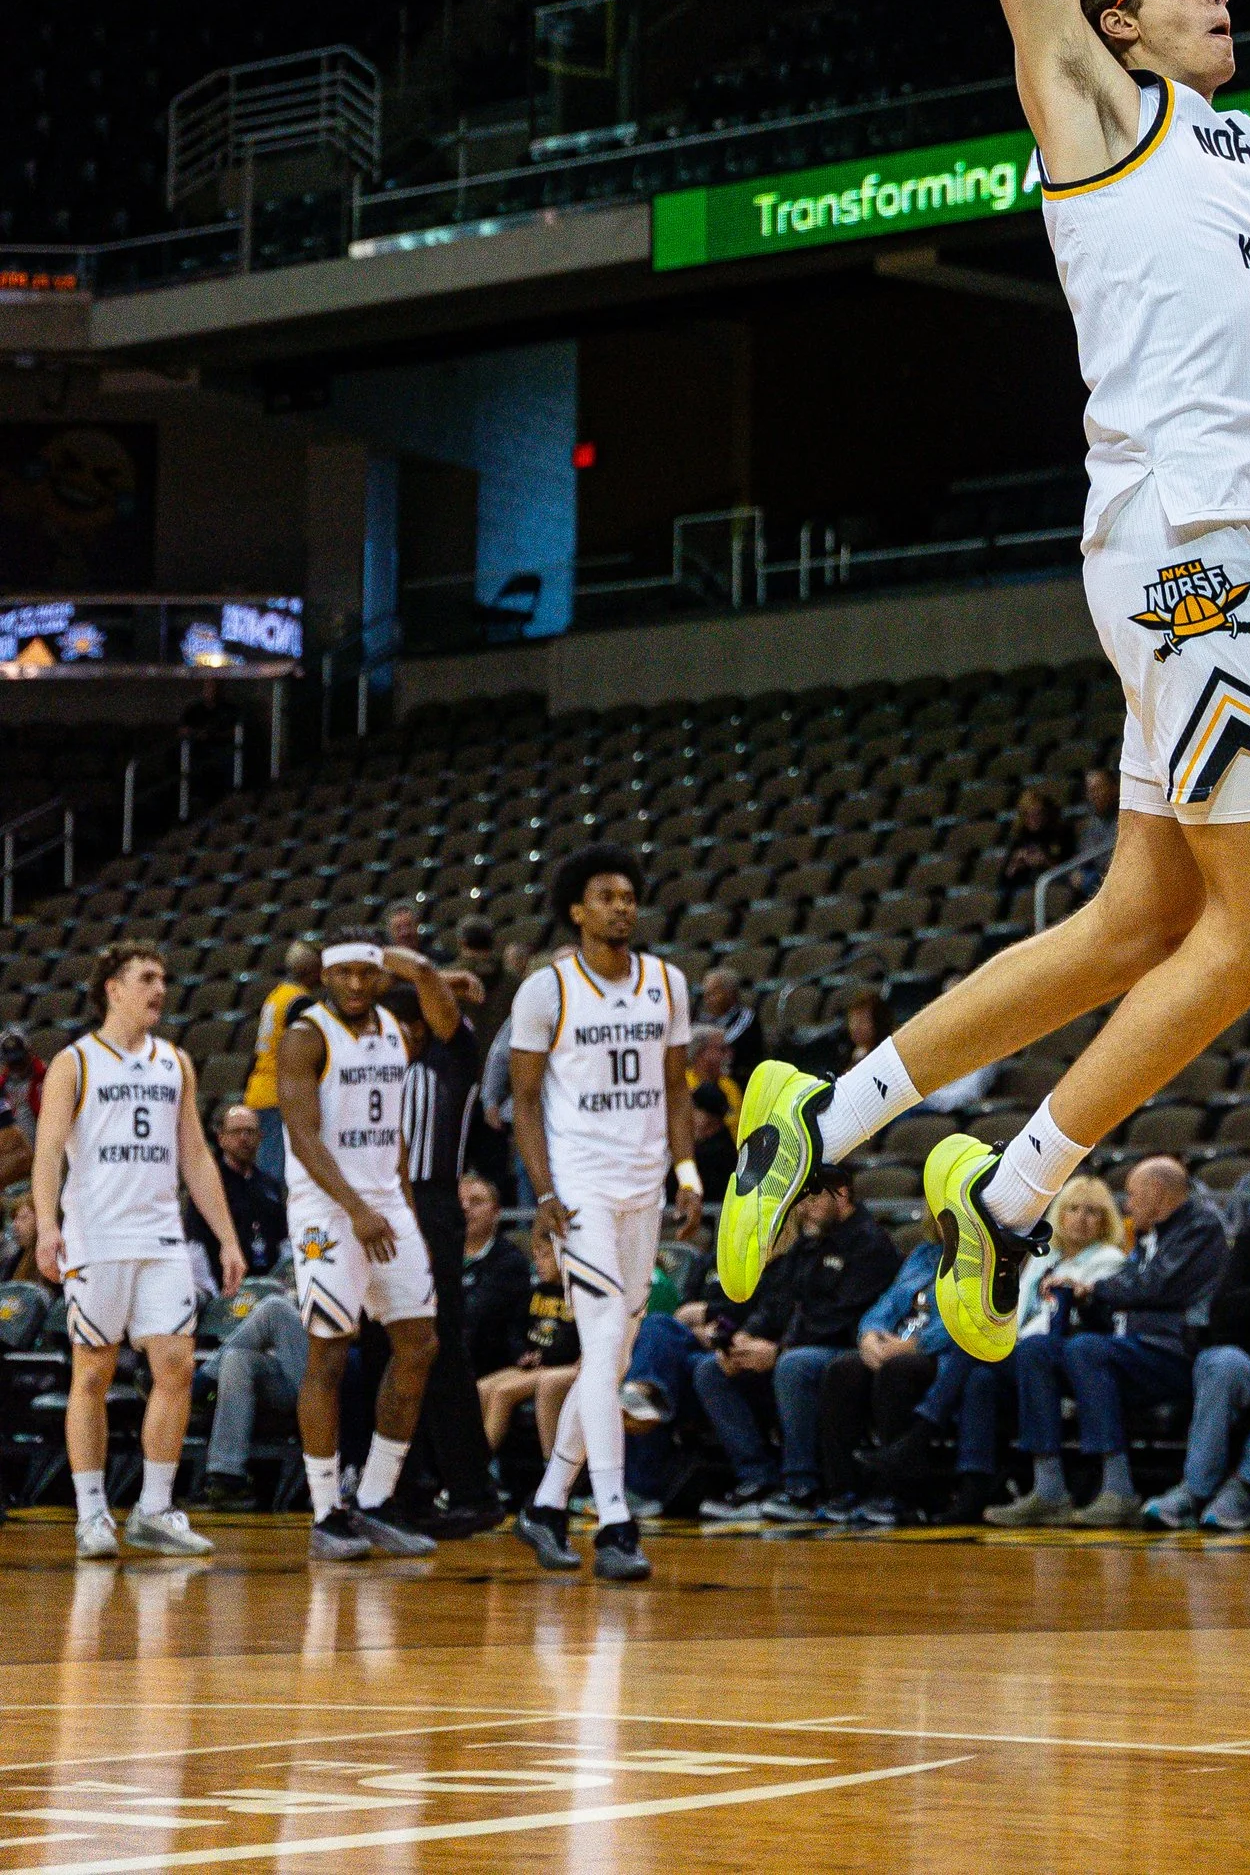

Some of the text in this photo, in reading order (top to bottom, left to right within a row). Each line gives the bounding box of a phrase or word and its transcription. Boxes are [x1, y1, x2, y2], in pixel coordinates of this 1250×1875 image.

[753, 161, 1017, 237] Transforming
[1161, 562, 1202, 582] NKU
[575, 1022, 664, 1045] NORTHERN
[608, 1047, 640, 1086] 10
[98, 1083, 176, 1102] NORTHERN
[368, 1089, 383, 1123] 8
[578, 1090, 661, 1113] KENTUCKY
[133, 1106, 151, 1140] 6
